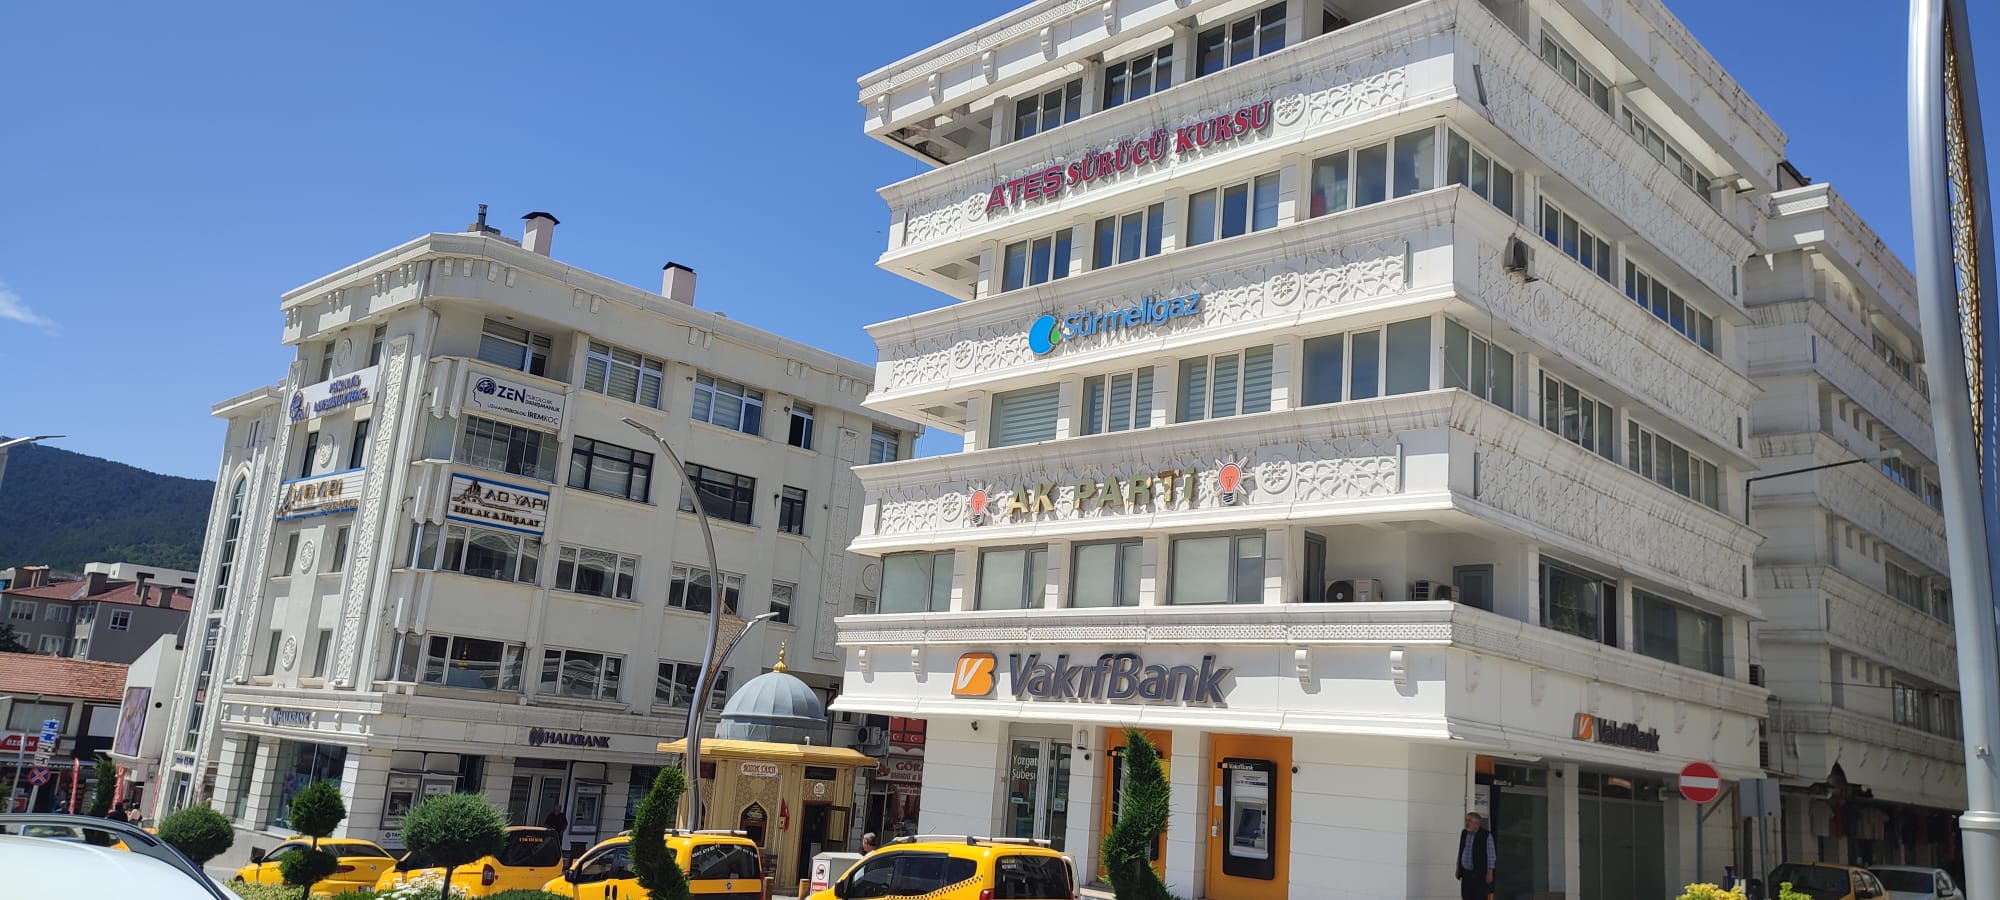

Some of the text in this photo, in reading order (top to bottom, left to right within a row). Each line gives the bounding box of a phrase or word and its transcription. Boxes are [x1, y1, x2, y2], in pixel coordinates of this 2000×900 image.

[985, 100, 1273, 214] ATEŞ SÜRÜCÜ KURSU
[1061, 292, 1202, 340] Sürmeligaz
[497, 385, 526, 404] ZEN
[511, 493, 546, 510] YAPI
[1007, 467, 1197, 516] AK PARTİ
[454, 505, 490, 519] EMLAK
[501, 512, 541, 528] İNŞAAT
[1009, 653, 1233, 708] VakıfBank
[544, 731, 611, 748] HALKBANK
[1597, 717, 1660, 752] VakıfBank
[1013, 754, 1038, 769] Yozgat
